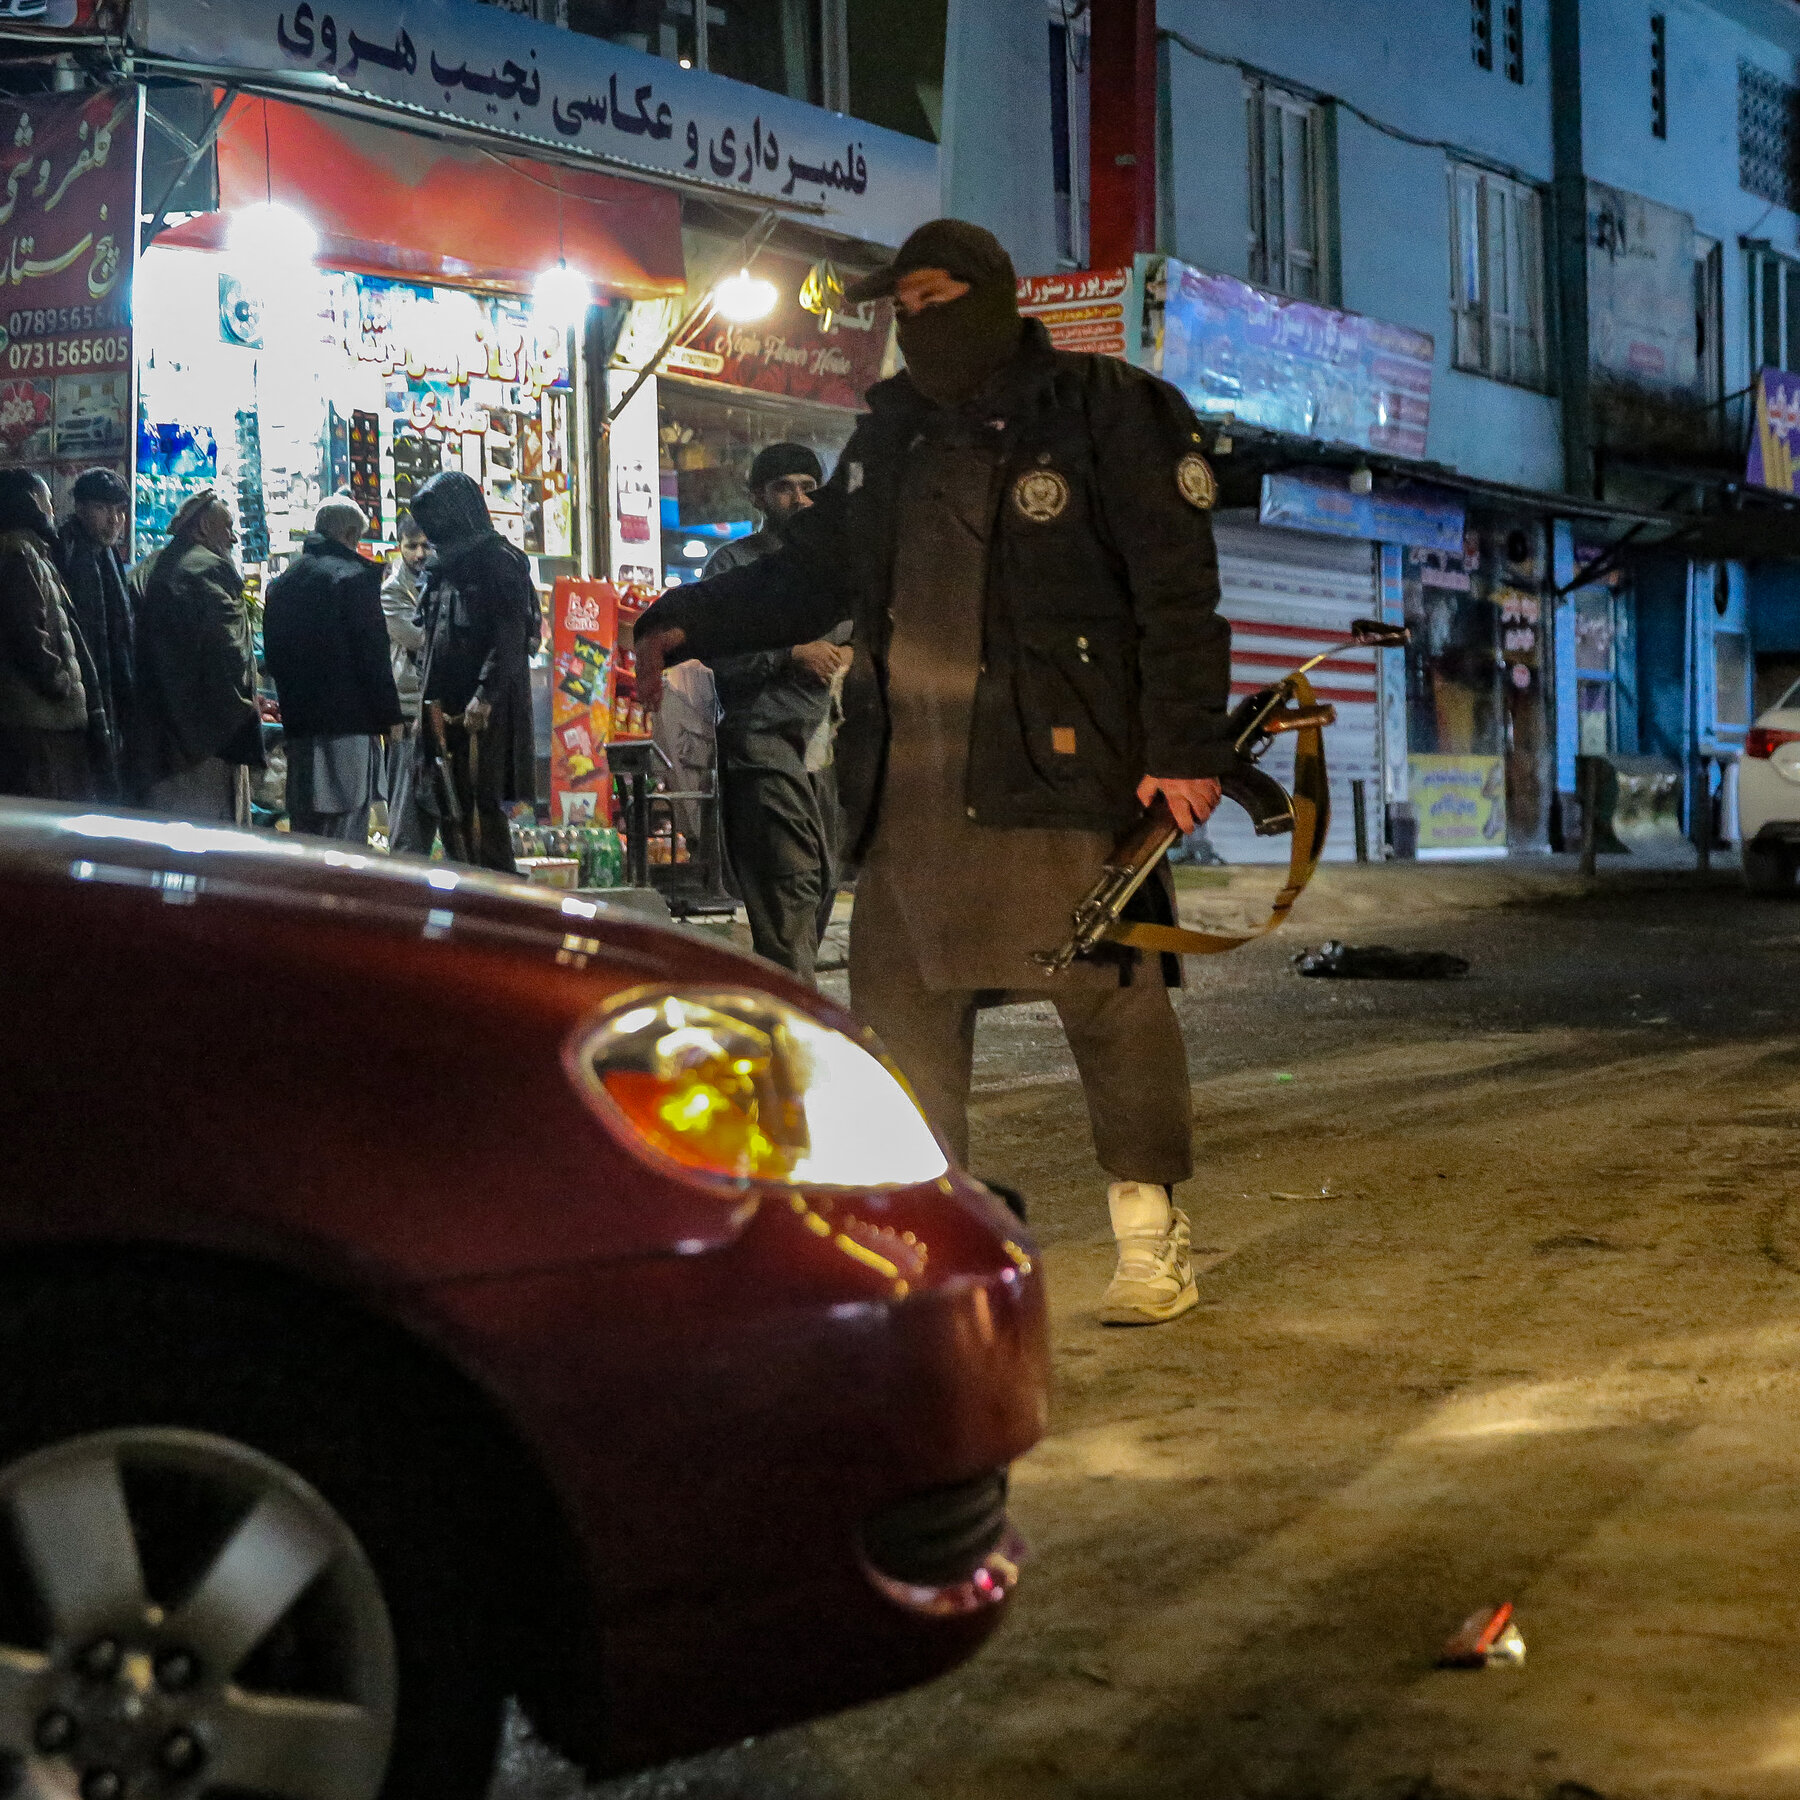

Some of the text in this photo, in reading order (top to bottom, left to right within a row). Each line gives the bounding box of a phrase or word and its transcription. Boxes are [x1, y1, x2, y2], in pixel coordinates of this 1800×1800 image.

[277, 2, 417, 77] هروی
[430, 48, 541, 122] نجیب
[552, 72, 673, 141] عکاسی
[683, 120, 699, 171] و
[9, 336, 128, 369] 0731565605
